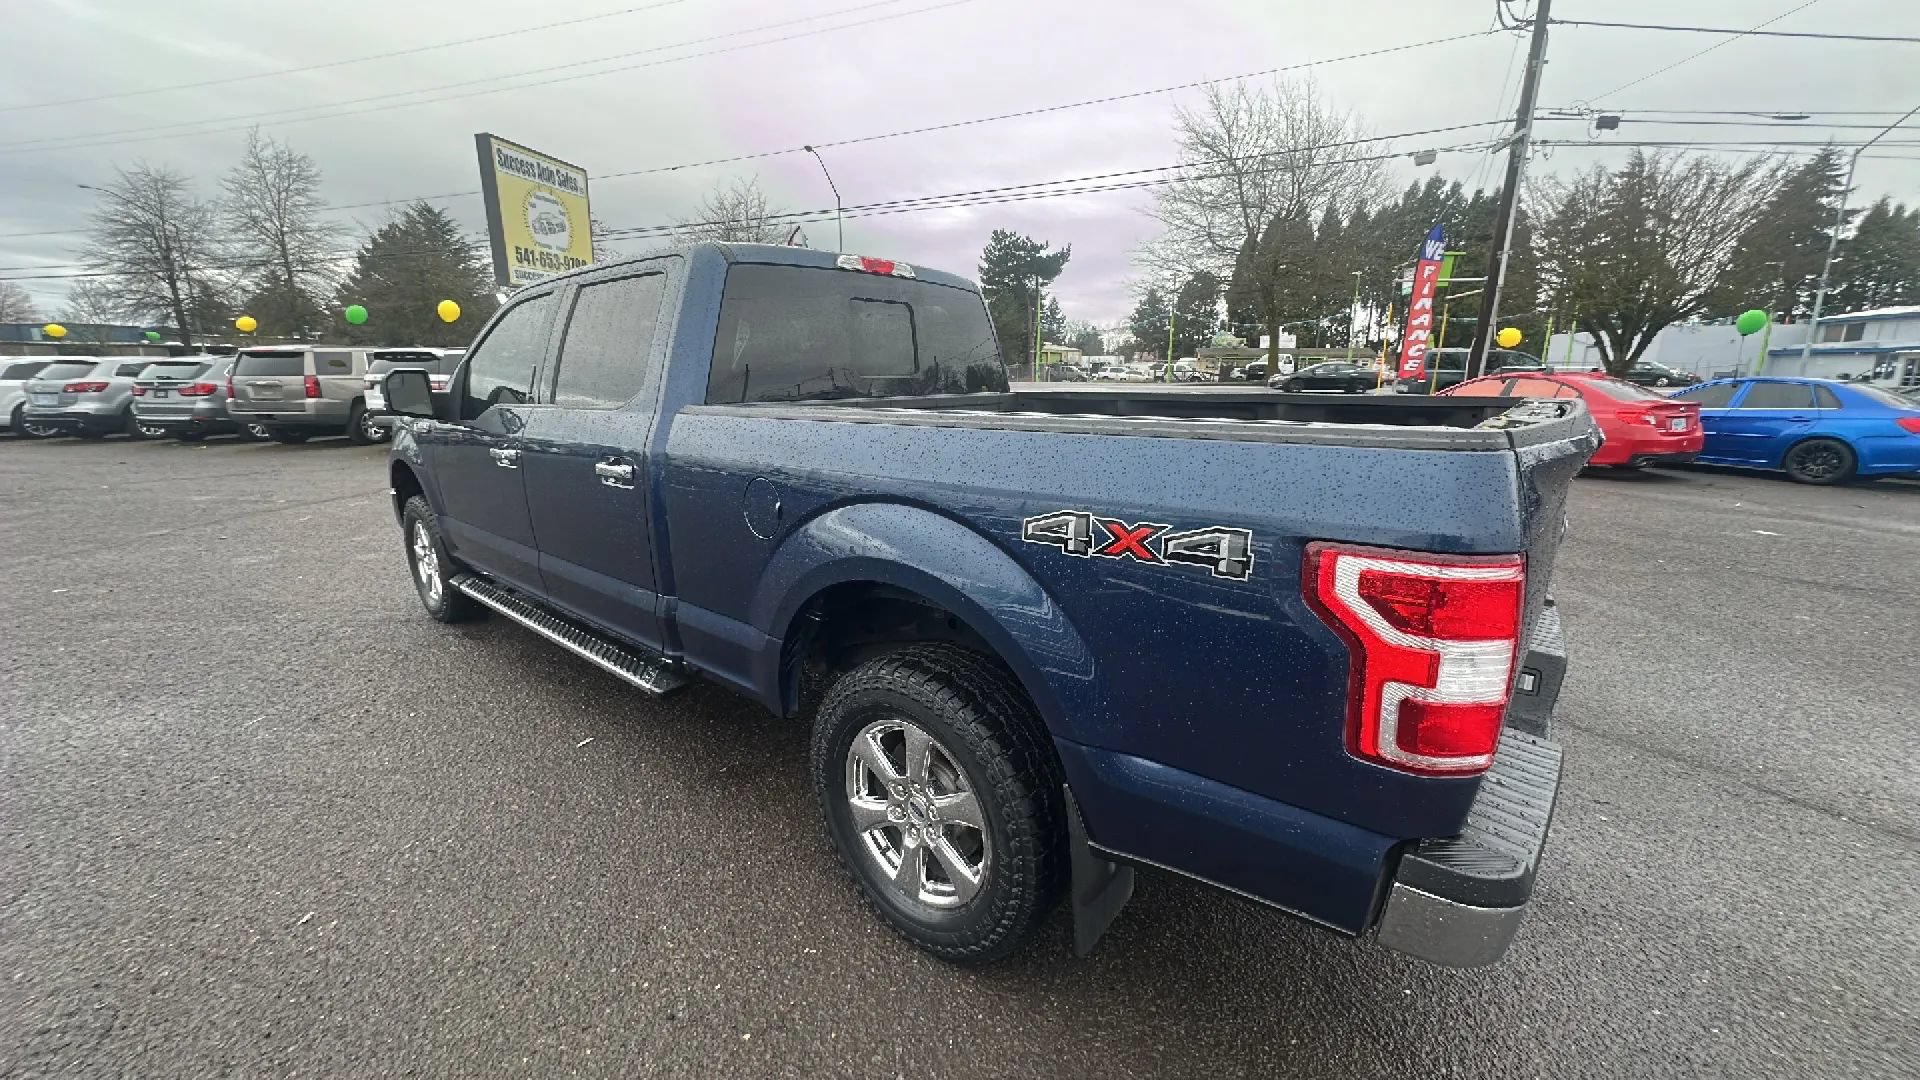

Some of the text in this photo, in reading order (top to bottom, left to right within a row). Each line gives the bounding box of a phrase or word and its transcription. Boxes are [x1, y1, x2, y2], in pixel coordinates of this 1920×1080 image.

[496, 147, 579, 192] Success Auto Sales
[1425, 239, 1445, 261] WE
[1403, 265, 1435, 371] FINANCE
